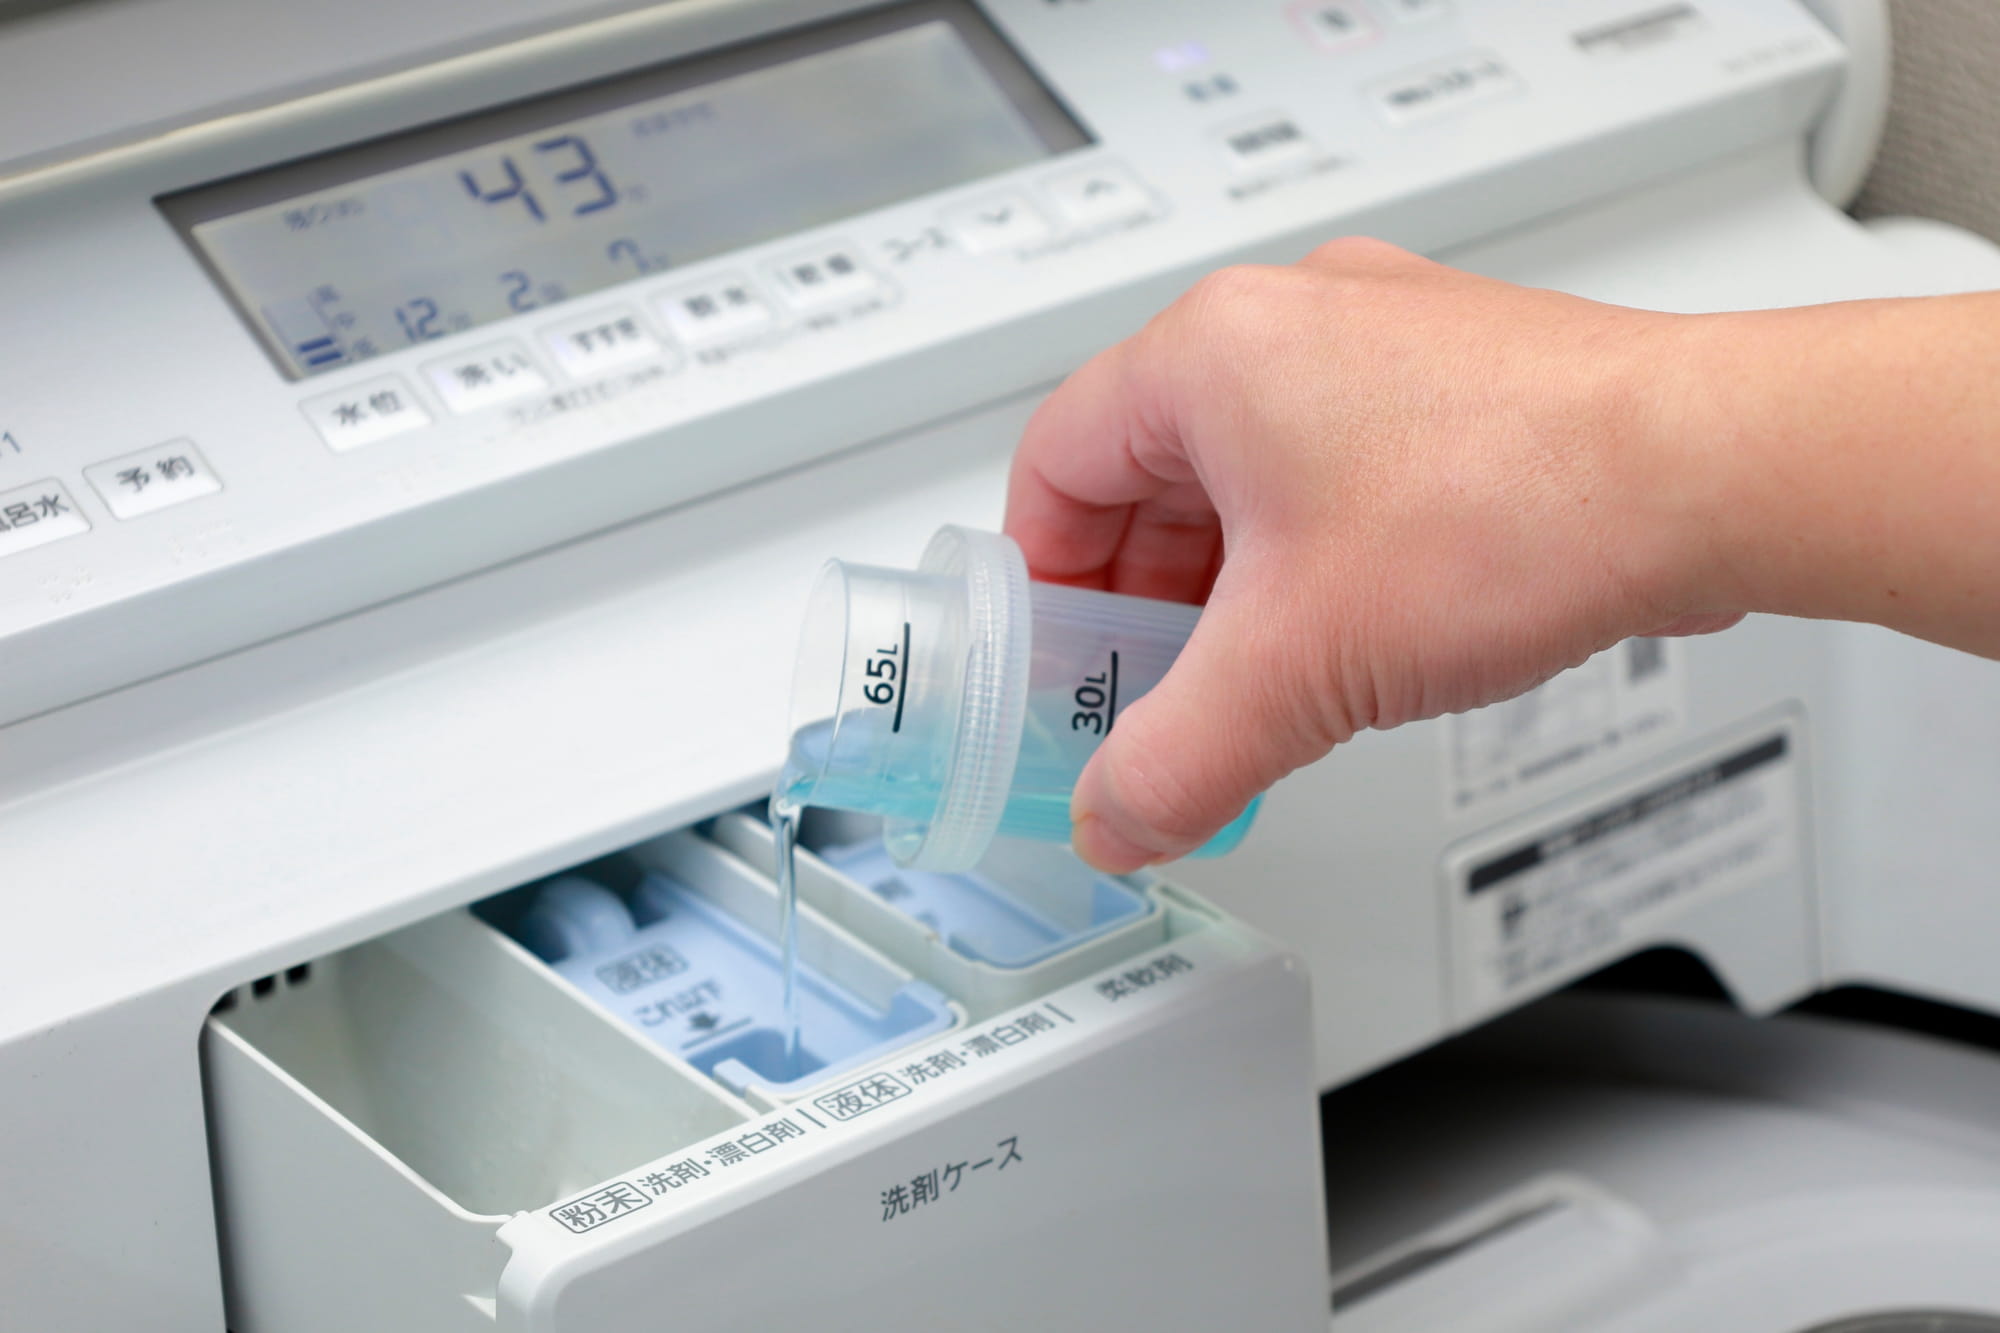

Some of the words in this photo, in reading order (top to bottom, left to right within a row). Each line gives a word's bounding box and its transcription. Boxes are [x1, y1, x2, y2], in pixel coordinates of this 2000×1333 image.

[459, 135, 617, 222] 43
[116, 455, 195, 492] 予約
[863, 643, 899, 705] 65L
[1072, 671, 1107, 735] 30L
[821, 1075, 900, 1116] 液体
[560, 1186, 643, 1228] 粉末
[880, 1135, 1023, 1222] 洗剤ケース
